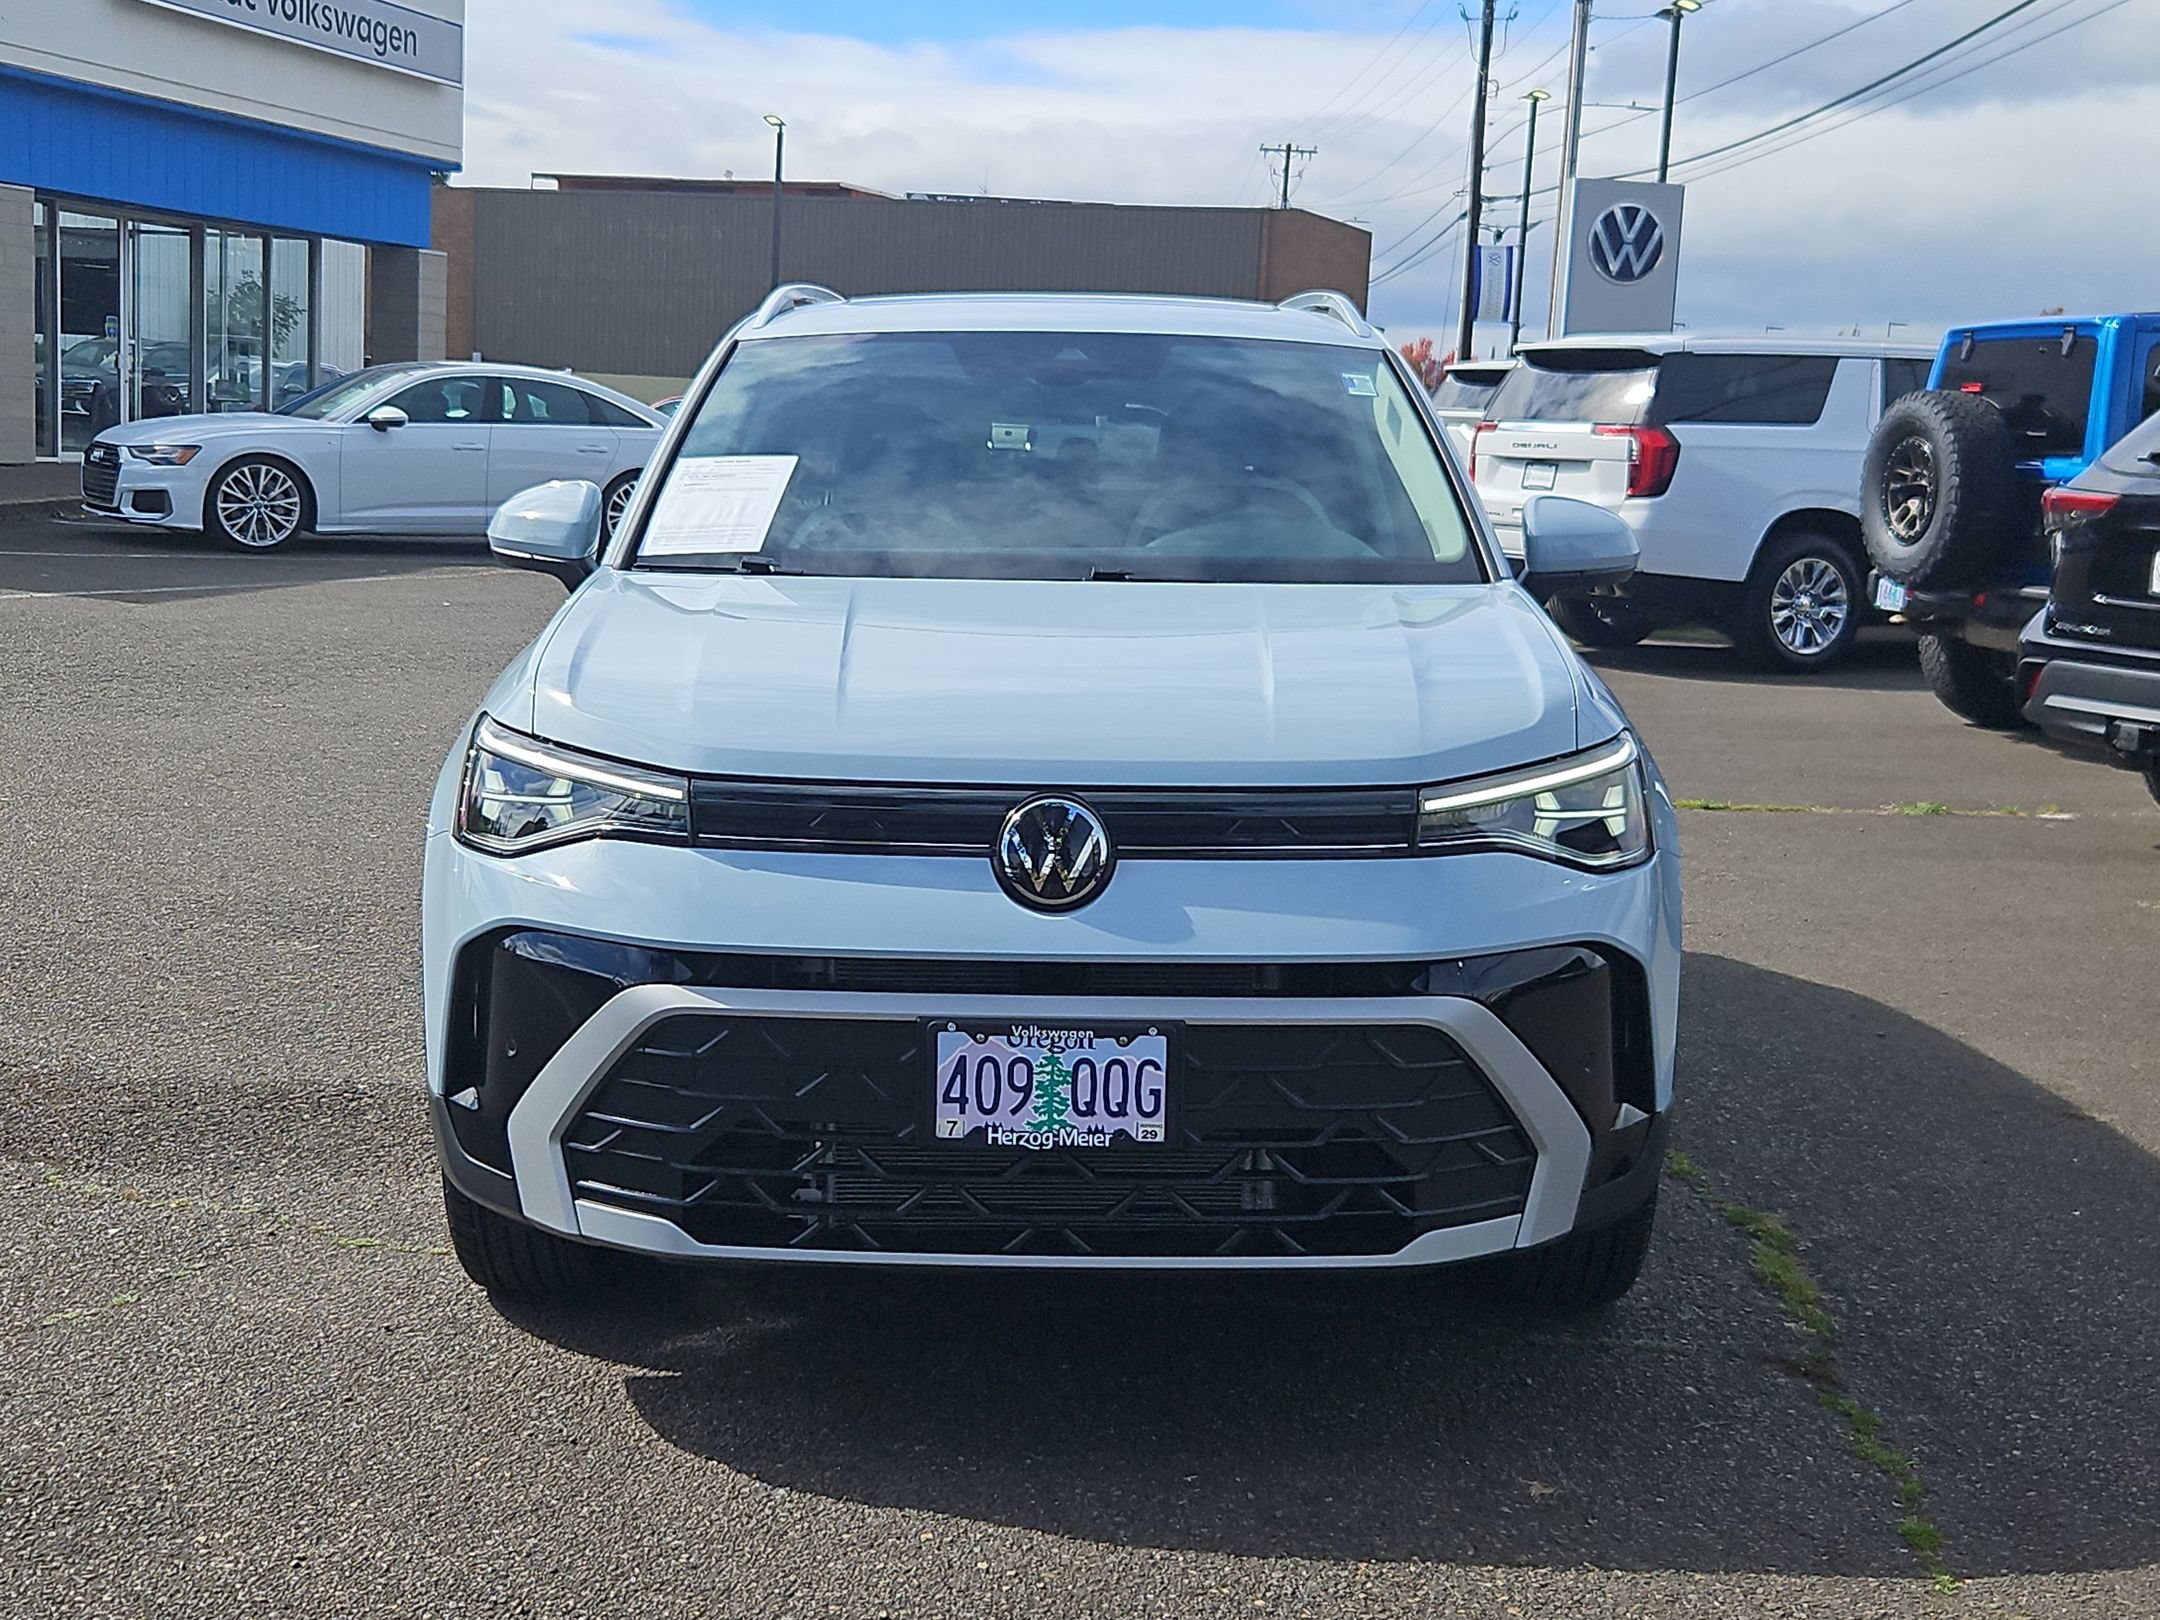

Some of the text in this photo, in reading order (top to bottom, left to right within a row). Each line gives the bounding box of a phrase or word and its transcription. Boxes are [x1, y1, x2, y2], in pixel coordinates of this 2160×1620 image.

[1011, 1024, 1094, 1040] Volkswagen
[942, 1054, 1162, 1118] 409 QQG
[946, 1120, 958, 1137] 7
[1140, 1129, 1158, 1140] 29
[986, 1125, 1114, 1150] Herzog-Meier
